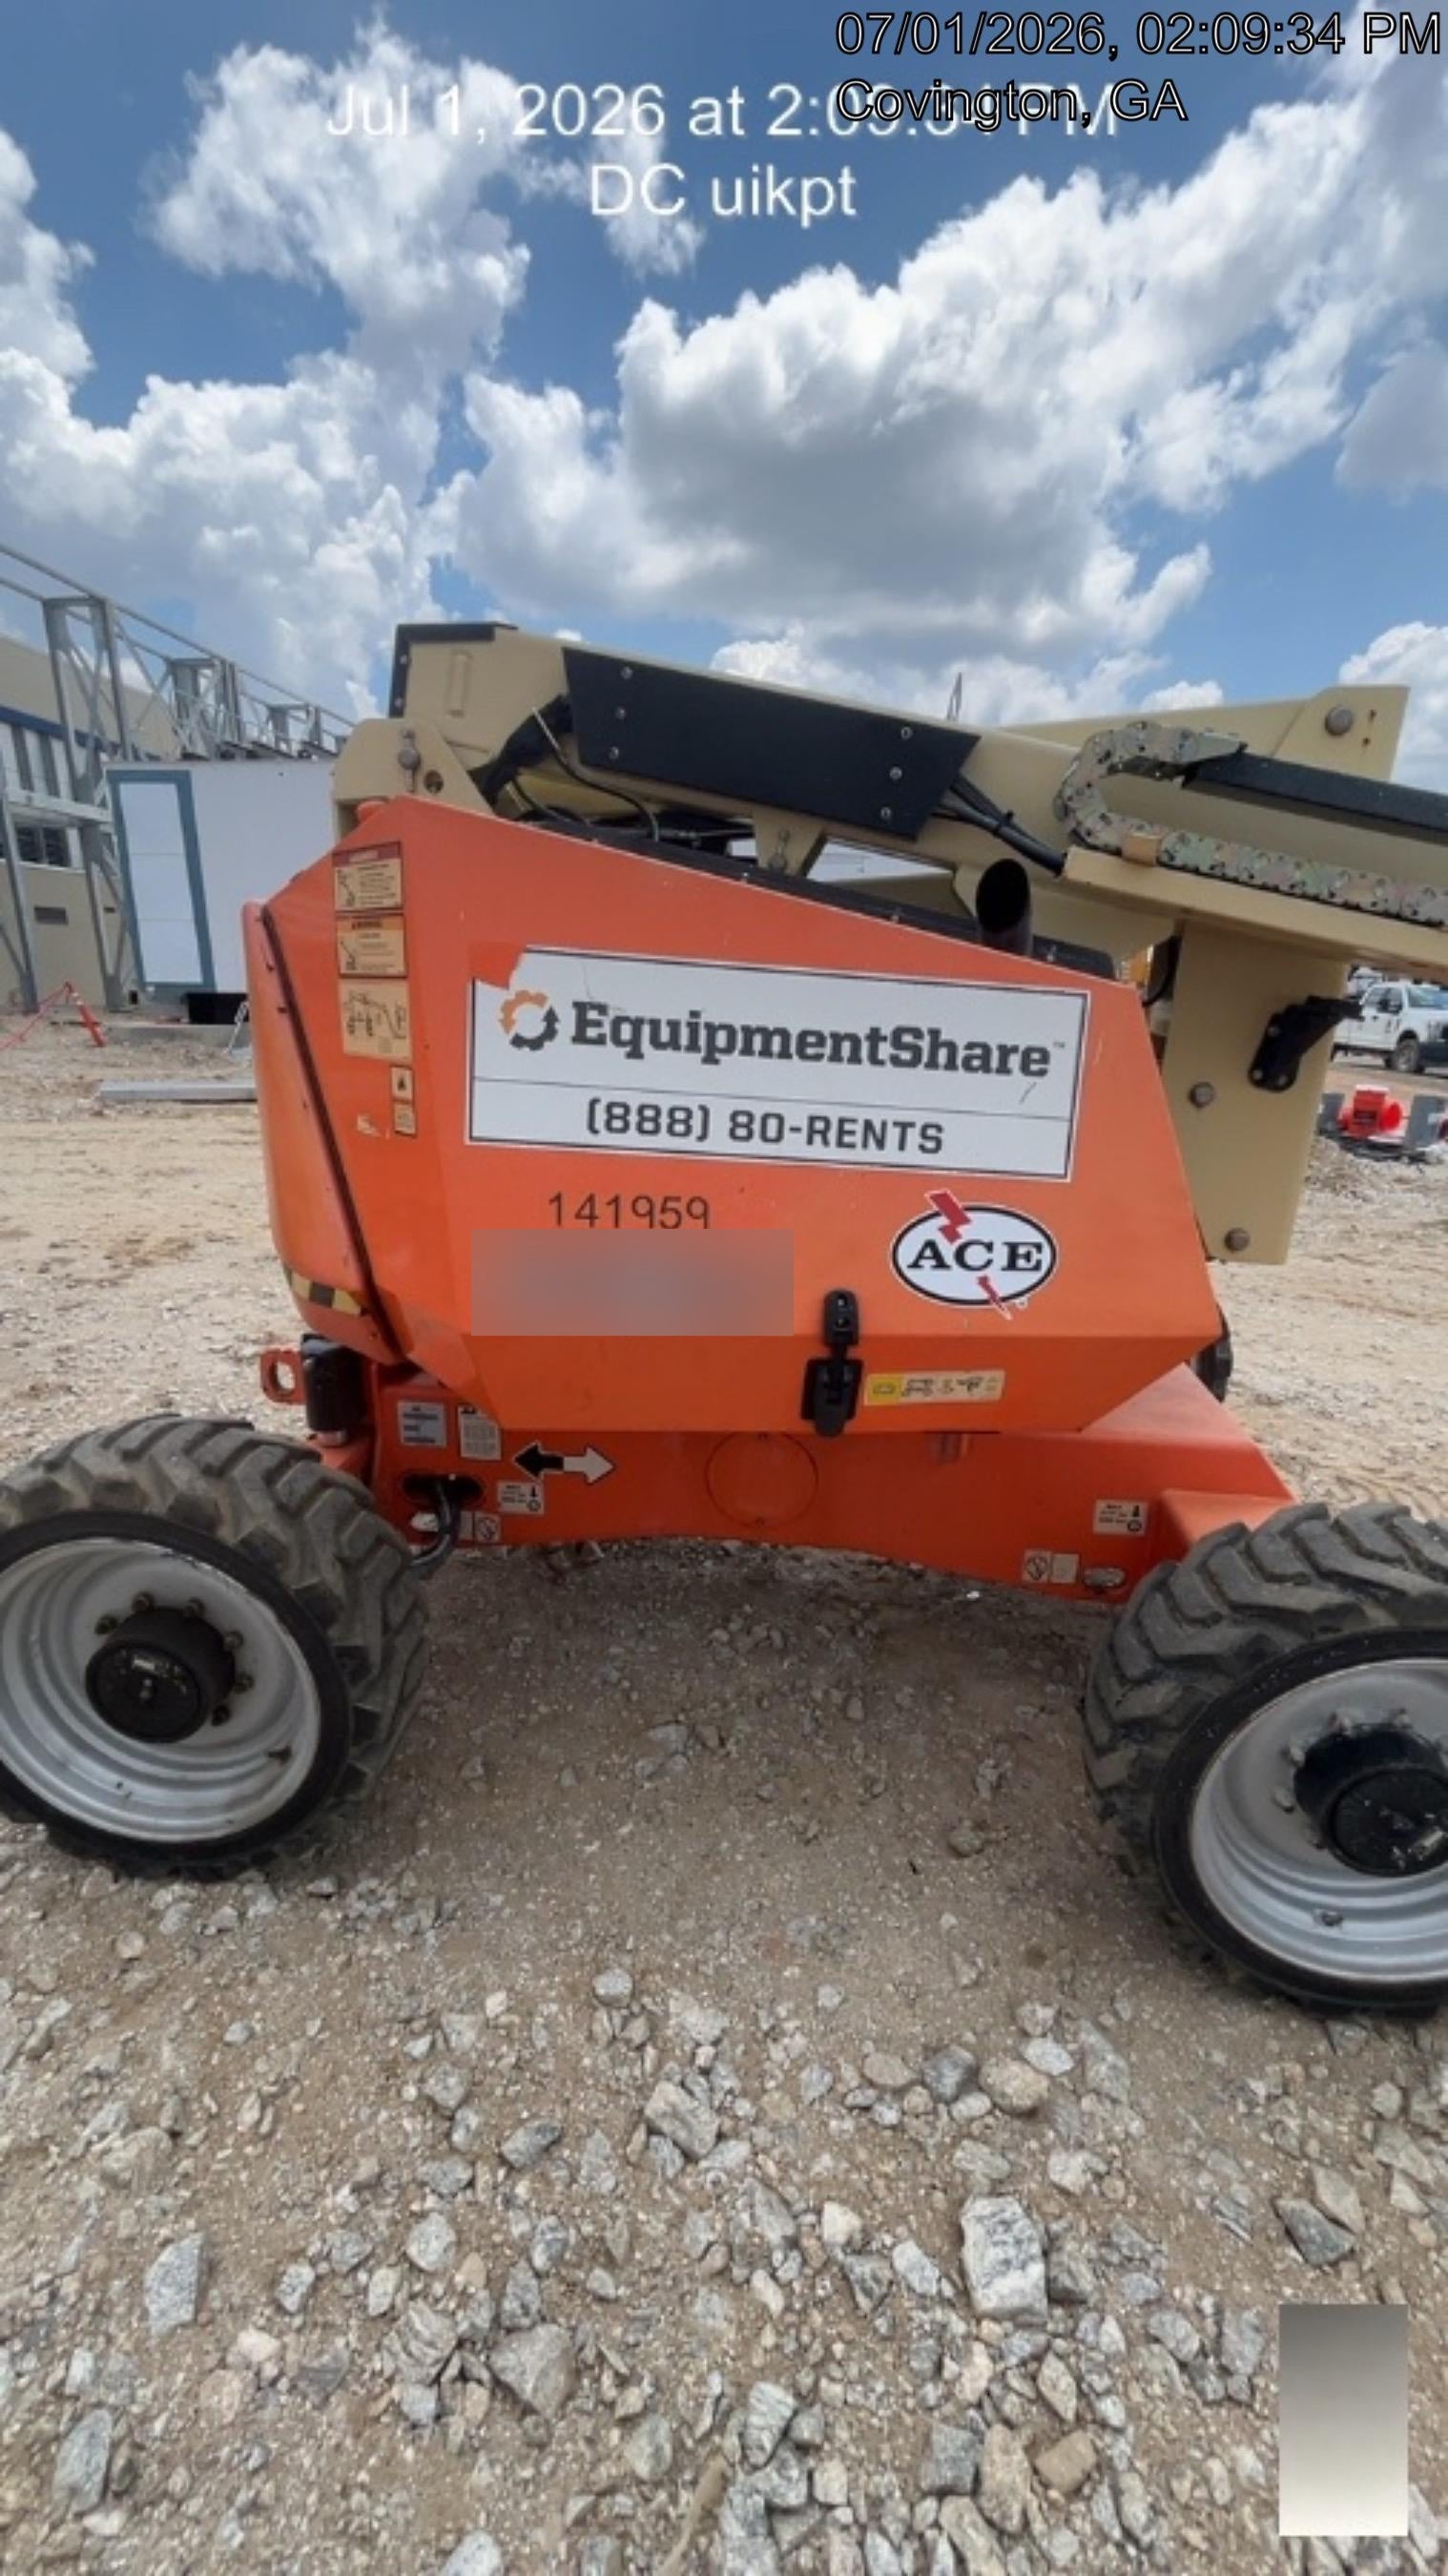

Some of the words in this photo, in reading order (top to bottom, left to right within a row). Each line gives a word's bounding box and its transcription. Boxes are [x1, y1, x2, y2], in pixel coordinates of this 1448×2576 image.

[570, 1000, 1050, 1078] EquipmentShare
[587, 1097, 711, 1143] (888)
[728, 1109, 944, 1154] 80-RENTS
[548, 1190, 710, 1230] 141959
[906, 1239, 1044, 1272] ACE
